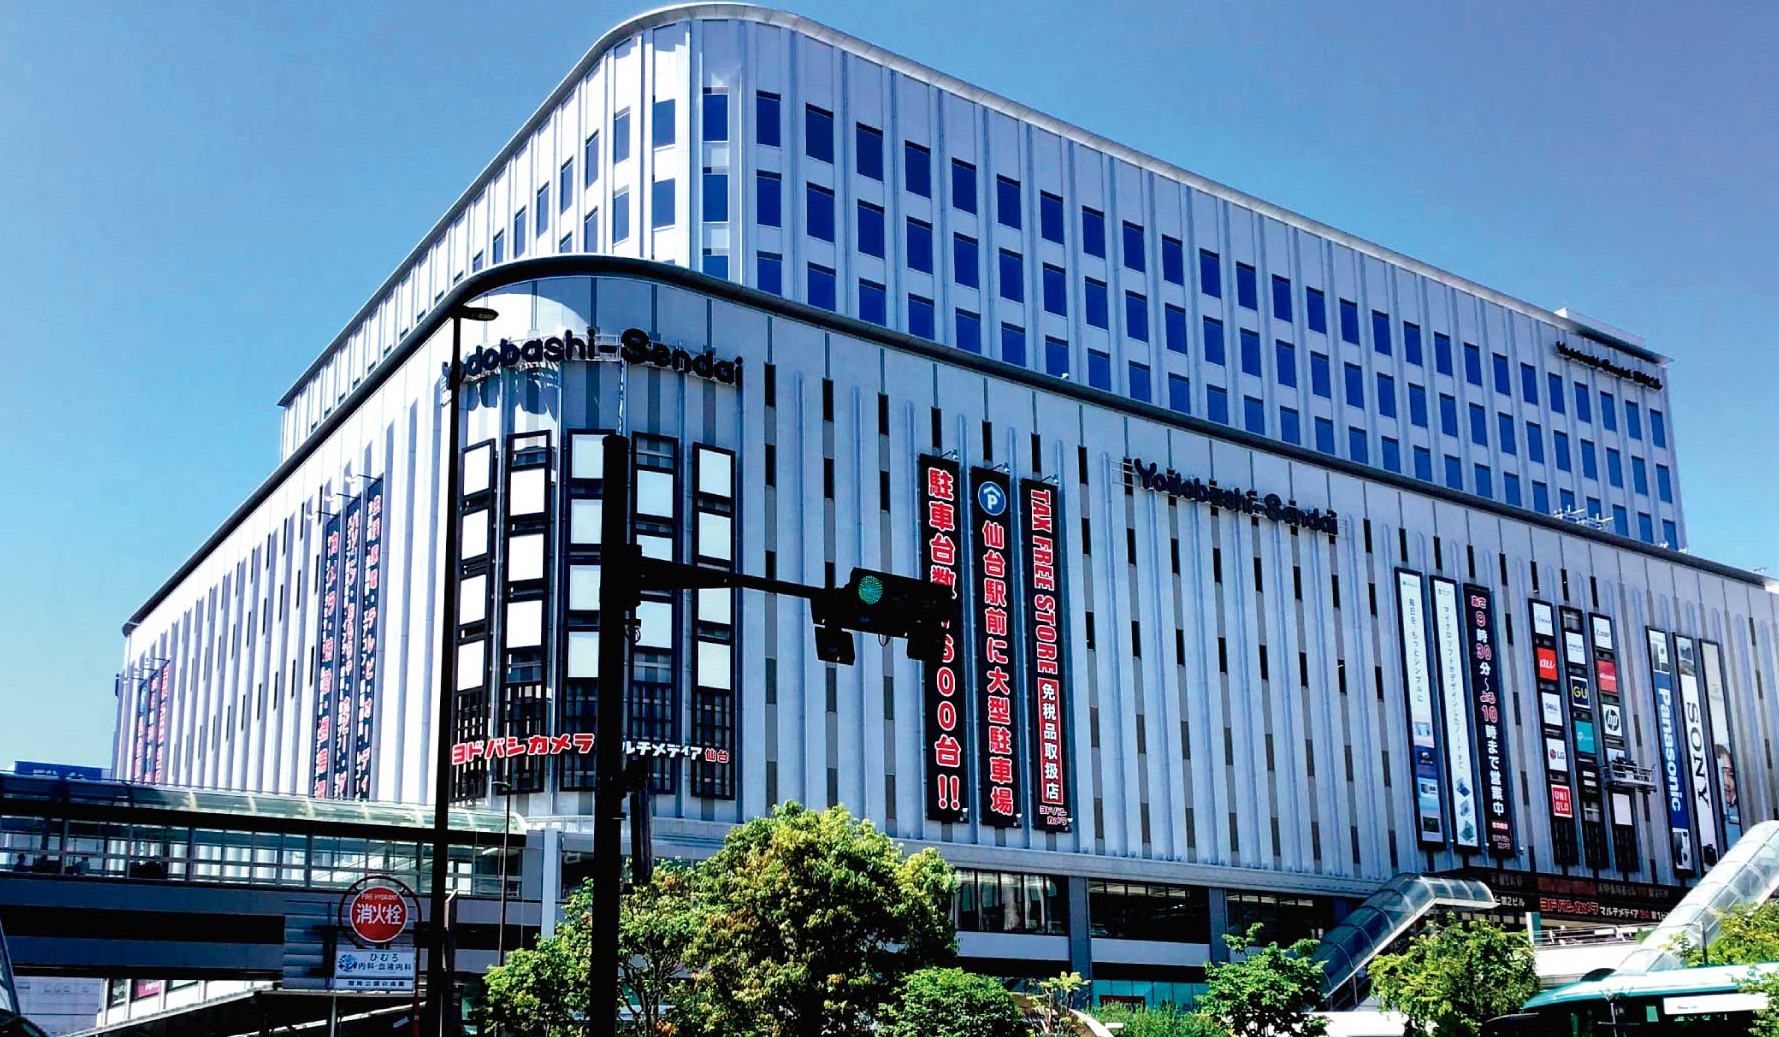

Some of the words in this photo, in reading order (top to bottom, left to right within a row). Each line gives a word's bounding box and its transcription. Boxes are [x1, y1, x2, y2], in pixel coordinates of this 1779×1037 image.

[1030, 488, 1052, 533] TAX
[1032, 535, 1056, 591] FREE
[1034, 593, 1058, 675] STORE
[982, 520, 1014, 816] 仙台駅前に大型駐車場
[1573, 686, 1588, 699] GU
[451, 732, 596, 766] ヨドバシカメラ
[621, 740, 702, 760] ルチメディア
[704, 747, 730, 763] 仙台
[1041, 682, 1060, 800] 免税品取扱店
[1556, 751, 1566, 760] LG
[1658, 688, 1683, 811] Panasonic
[1686, 702, 1710, 808] SONY
[1554, 791, 1568, 801] UNI
[1555, 801, 1569, 812] QLO
[356, 903, 403, 925] 消火栓
[369, 953, 399, 962] ひむろ
